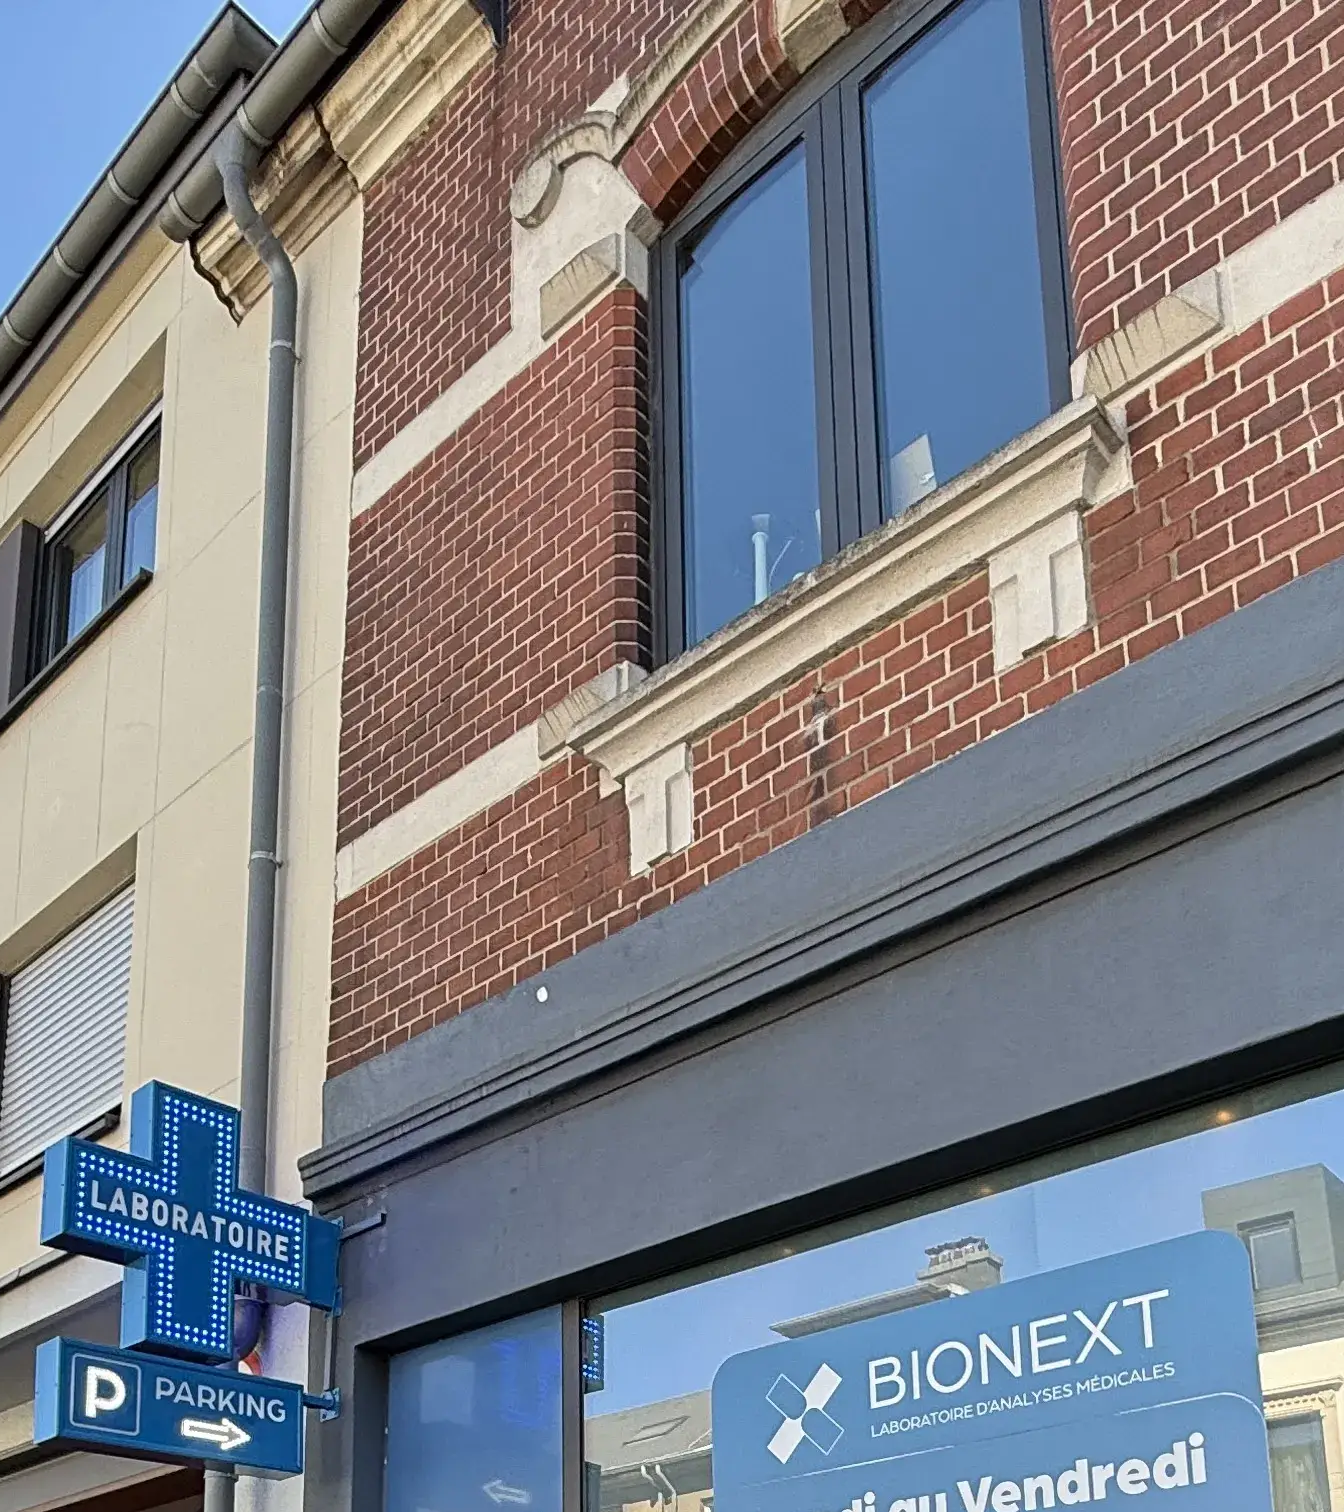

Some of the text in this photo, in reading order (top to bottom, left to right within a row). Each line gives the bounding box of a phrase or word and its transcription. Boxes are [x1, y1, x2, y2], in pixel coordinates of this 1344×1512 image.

[90, 1179, 290, 1263] LABORATOIRE
[868, 1289, 1170, 1410] BIONEXT
[84, 1364, 127, 1419] P
[155, 1376, 287, 1424] PARKING
[870, 1361, 1176, 1438] LABORATOIRE D'ANALYSES MÉDICALES
